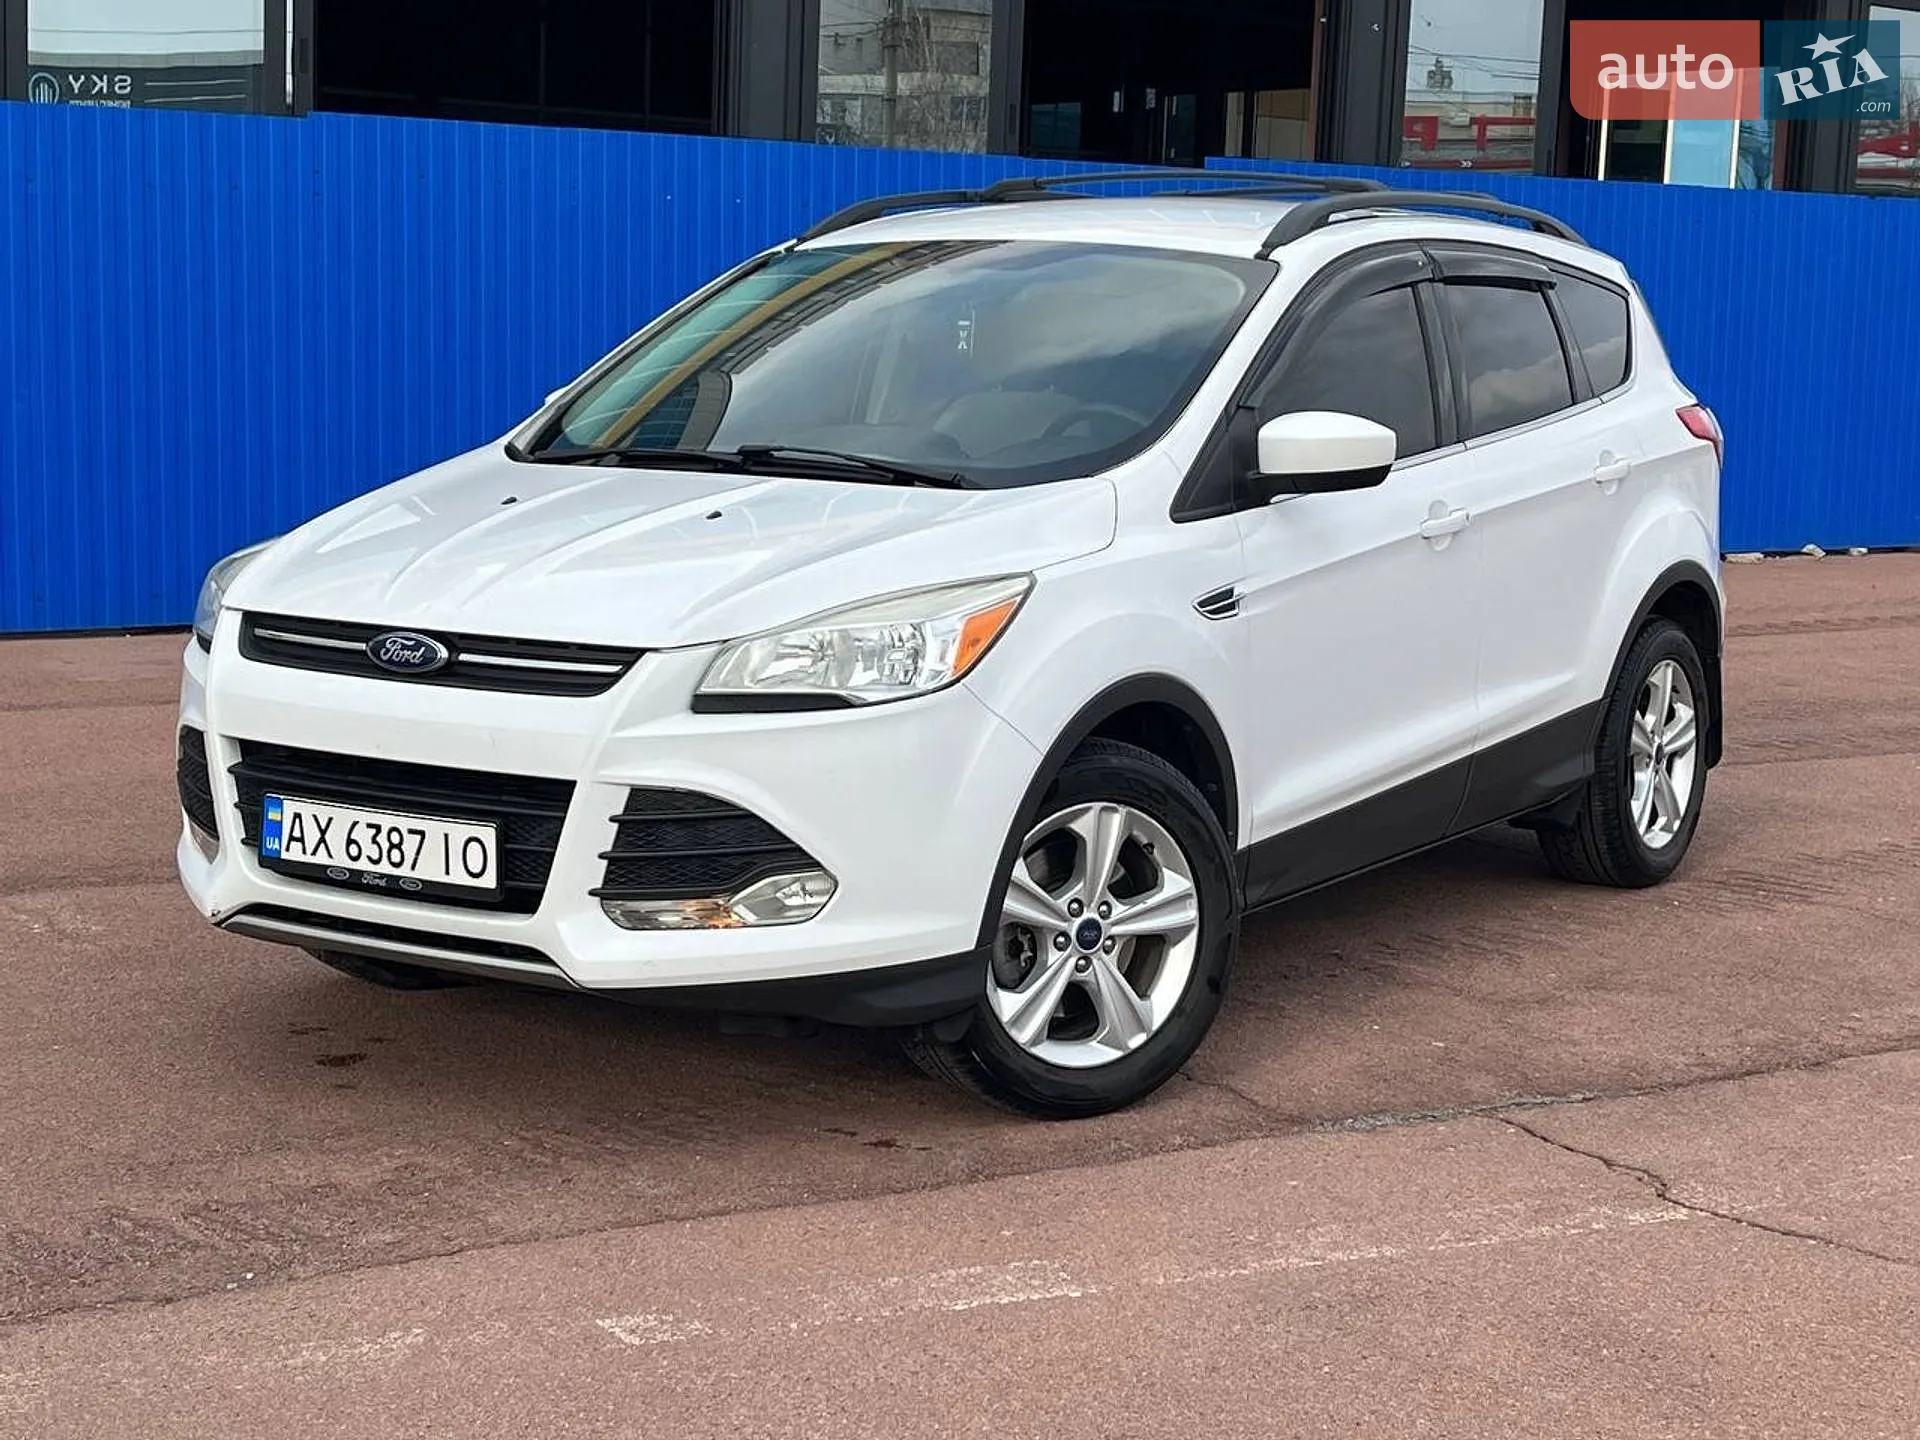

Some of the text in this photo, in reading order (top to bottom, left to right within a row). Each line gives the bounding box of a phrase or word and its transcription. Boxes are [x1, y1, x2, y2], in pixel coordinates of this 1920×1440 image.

[380, 637, 426, 663] Ford
[266, 836, 280, 850] UA
[285, 812, 334, 860] AX
[345, 820, 426, 872] 6387
[361, 872, 388, 887] Ford
